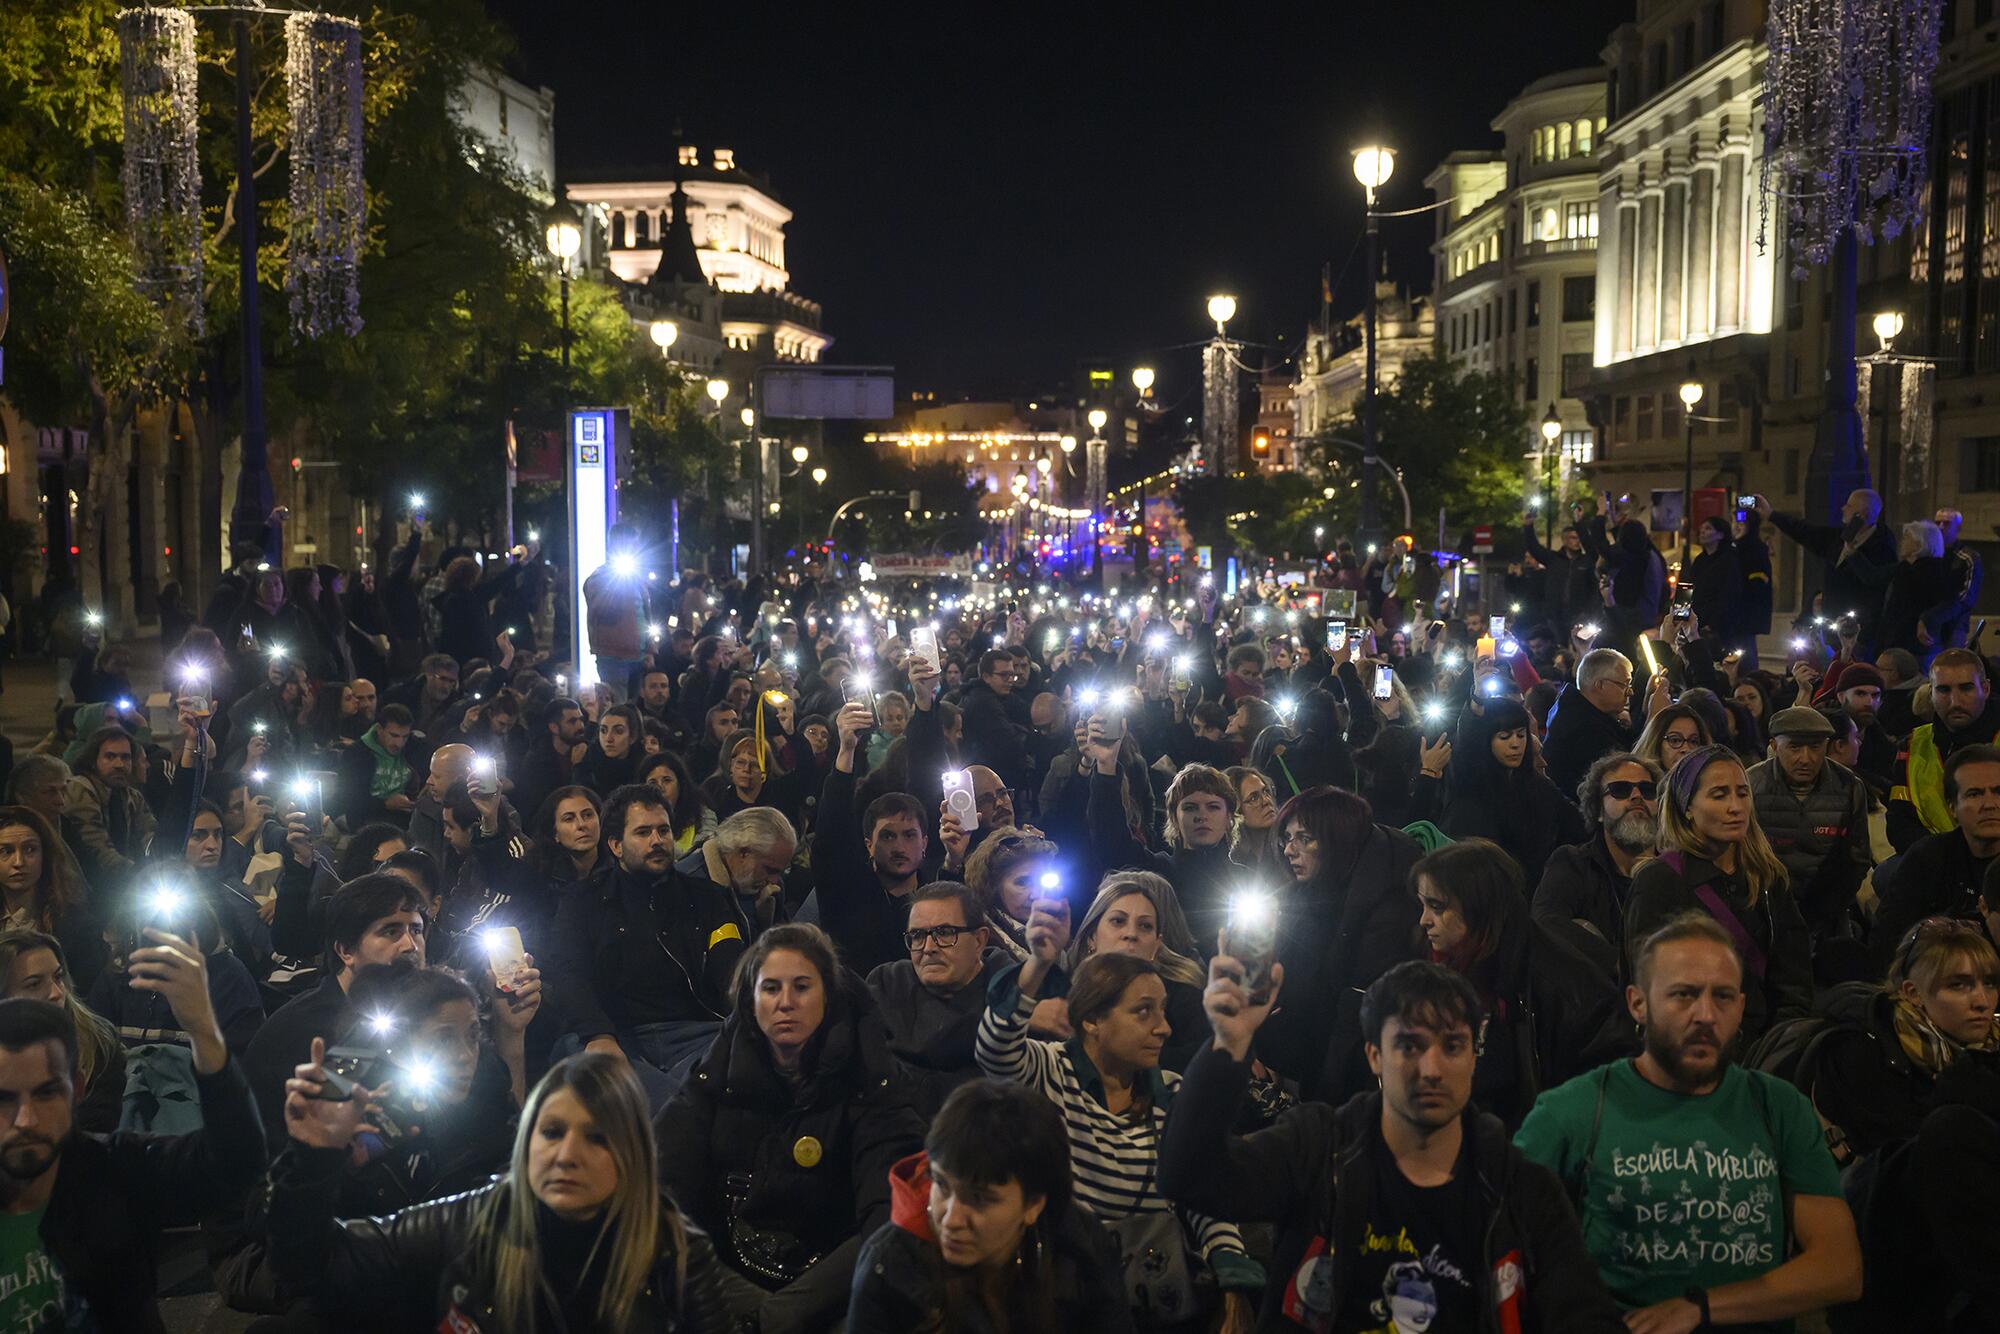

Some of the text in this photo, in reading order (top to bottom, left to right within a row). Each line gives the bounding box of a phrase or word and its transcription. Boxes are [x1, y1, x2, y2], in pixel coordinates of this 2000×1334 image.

[1614, 1147, 1699, 1177] ESCUELA
[1635, 1200, 1766, 1225] DE TOD@S
[1696, 1241, 1773, 1266] TOD@S
